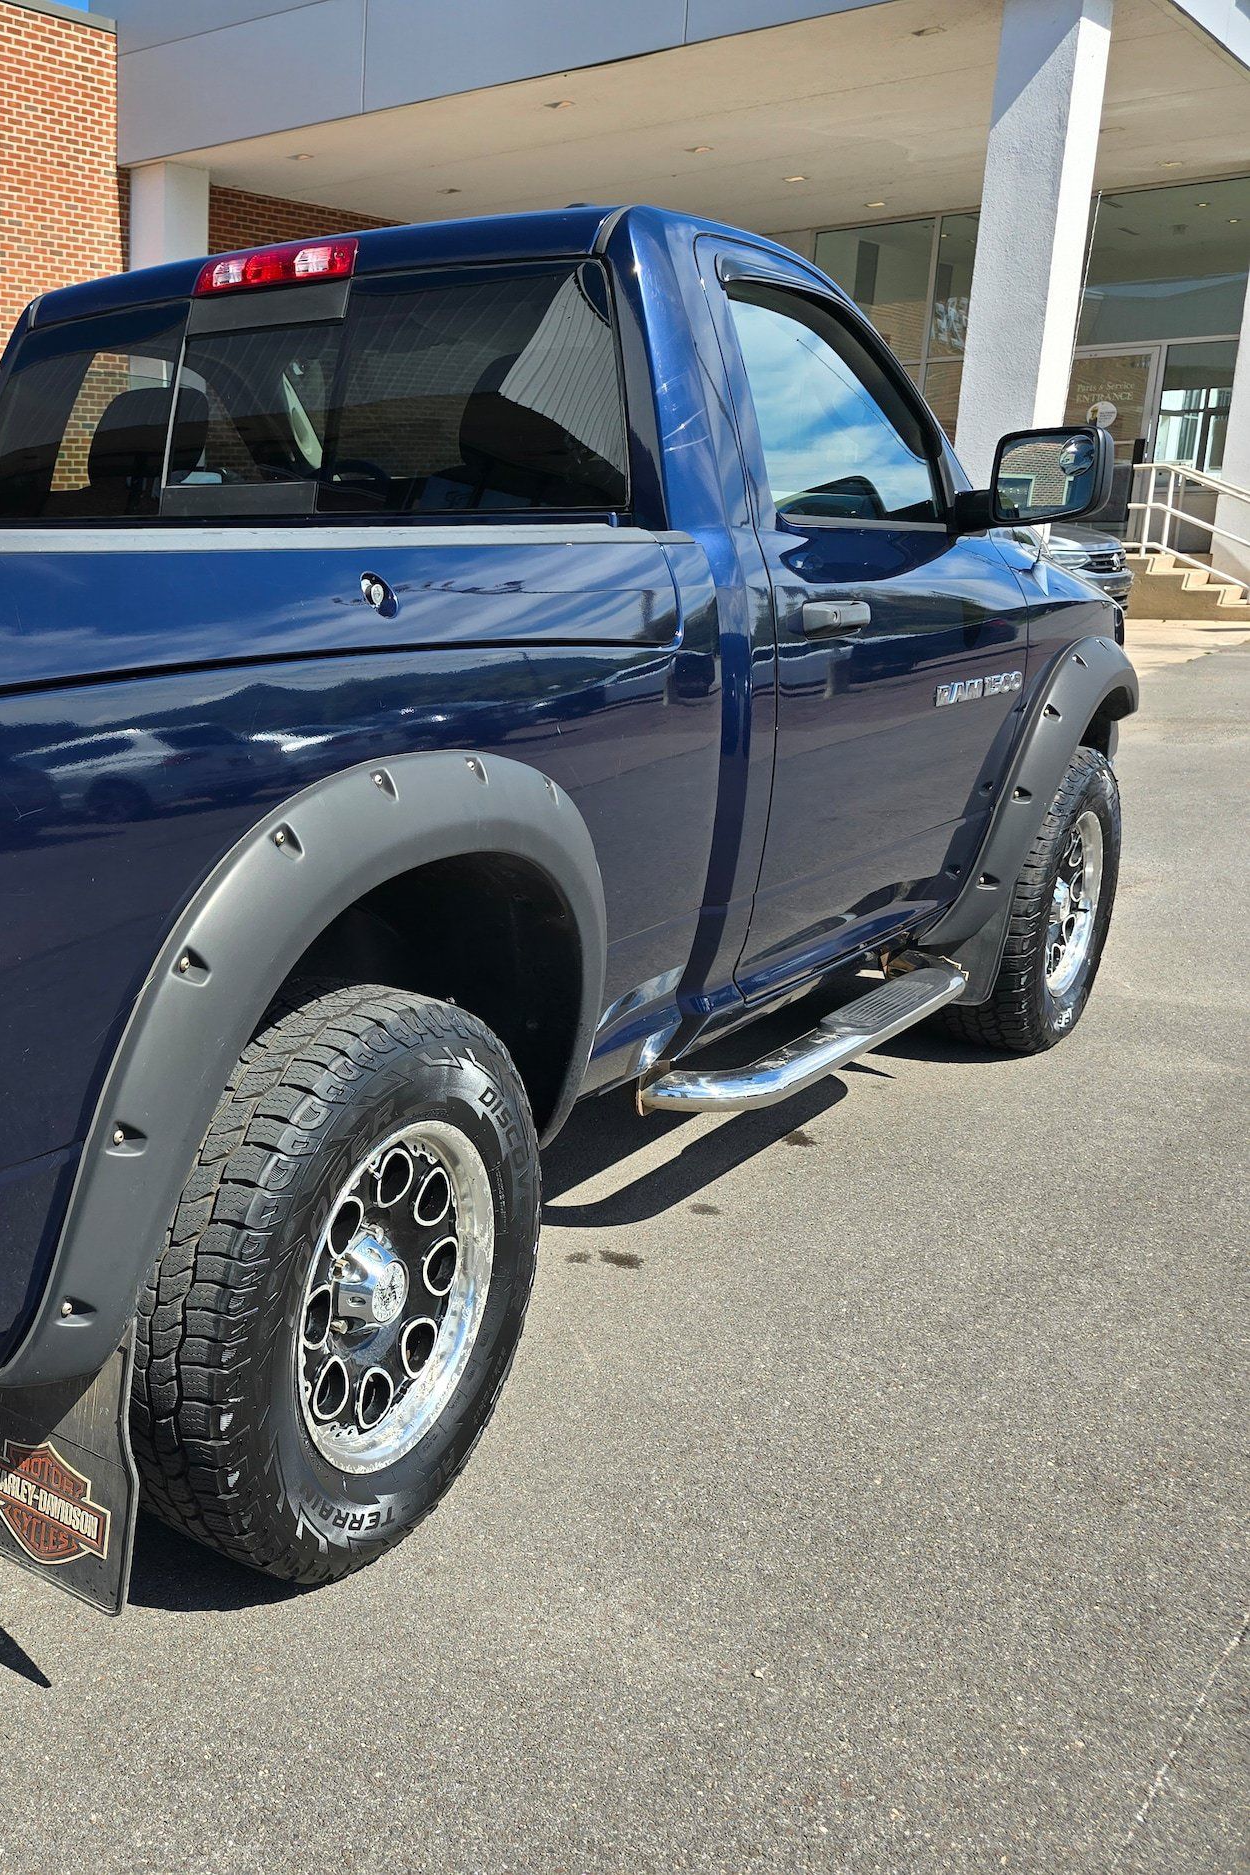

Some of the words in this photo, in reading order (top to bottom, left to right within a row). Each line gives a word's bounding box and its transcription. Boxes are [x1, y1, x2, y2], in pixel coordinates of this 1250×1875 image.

[1107, 381, 1135, 391] Service
[1076, 392, 1134, 403] ENTRANCE
[935, 678, 983, 707] RAM
[983, 670, 1023, 698] 1500
